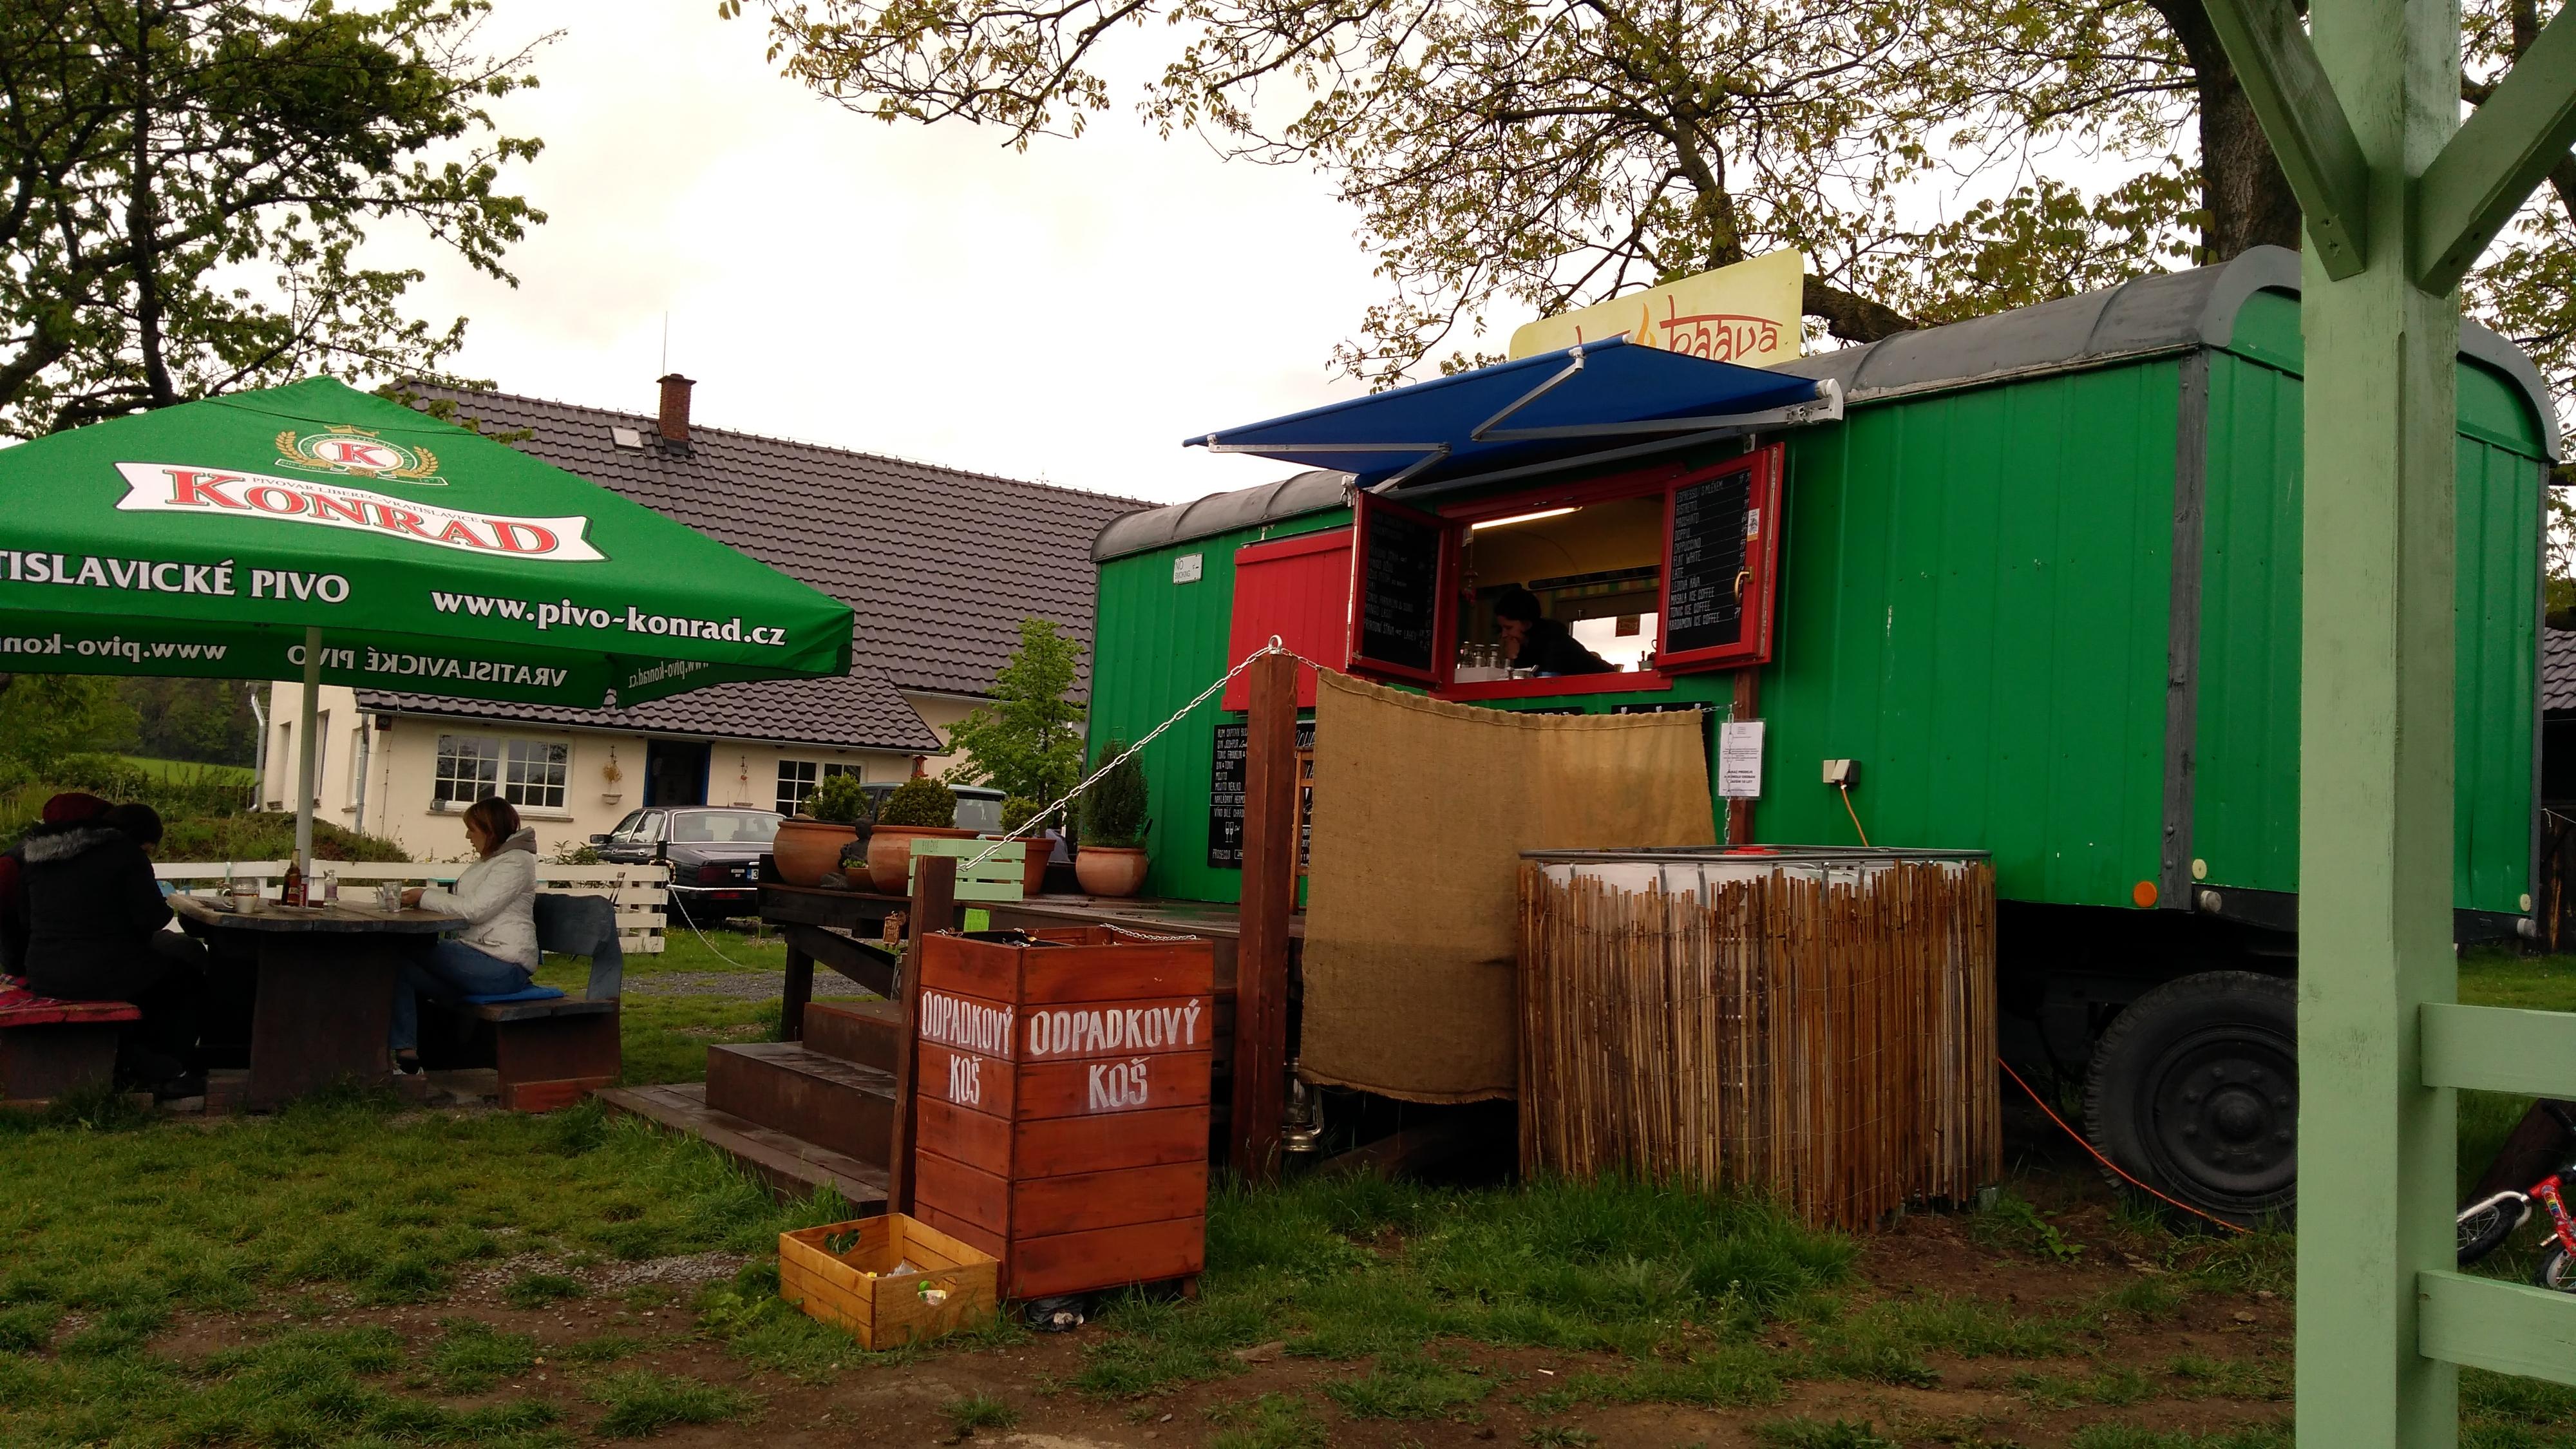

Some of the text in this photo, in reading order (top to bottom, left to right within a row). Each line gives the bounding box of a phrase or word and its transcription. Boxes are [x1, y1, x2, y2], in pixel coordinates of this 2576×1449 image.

[332, 442, 386, 467] K
[252, 477, 314, 491] PIVOVAR
[164, 469, 558, 554] KONRAD
[1175, 560, 1184, 571] NO
[1673, 554, 1684, 567] FLAT
[1685, 550, 1702, 564] WHITE
[251, 569, 350, 603] PIVO
[1689, 589, 1697, 601] ICE
[1698, 586, 1715, 600] COFFEE
[1669, 607, 1683, 618] TONIC
[1693, 600, 1710, 614] COFFEE
[430, 591, 788, 647] www.pivo-konrad.cz
[1702, 612, 1720, 625] COFFEE
[1217, 750, 1226, 760] TONIC
[1215, 772, 1227, 781] MOJITO
[1215, 781, 1227, 791] MOJITO
[1212, 848, 1231, 860] PROSECCO
[921, 990, 1014, 1055] ODPADKOVÝ
[1031, 998, 1201, 1056] ODPADKOVÝ
[949, 1054, 983, 1104] KOŠ
[1088, 1056, 1151, 1110] KOŠ
